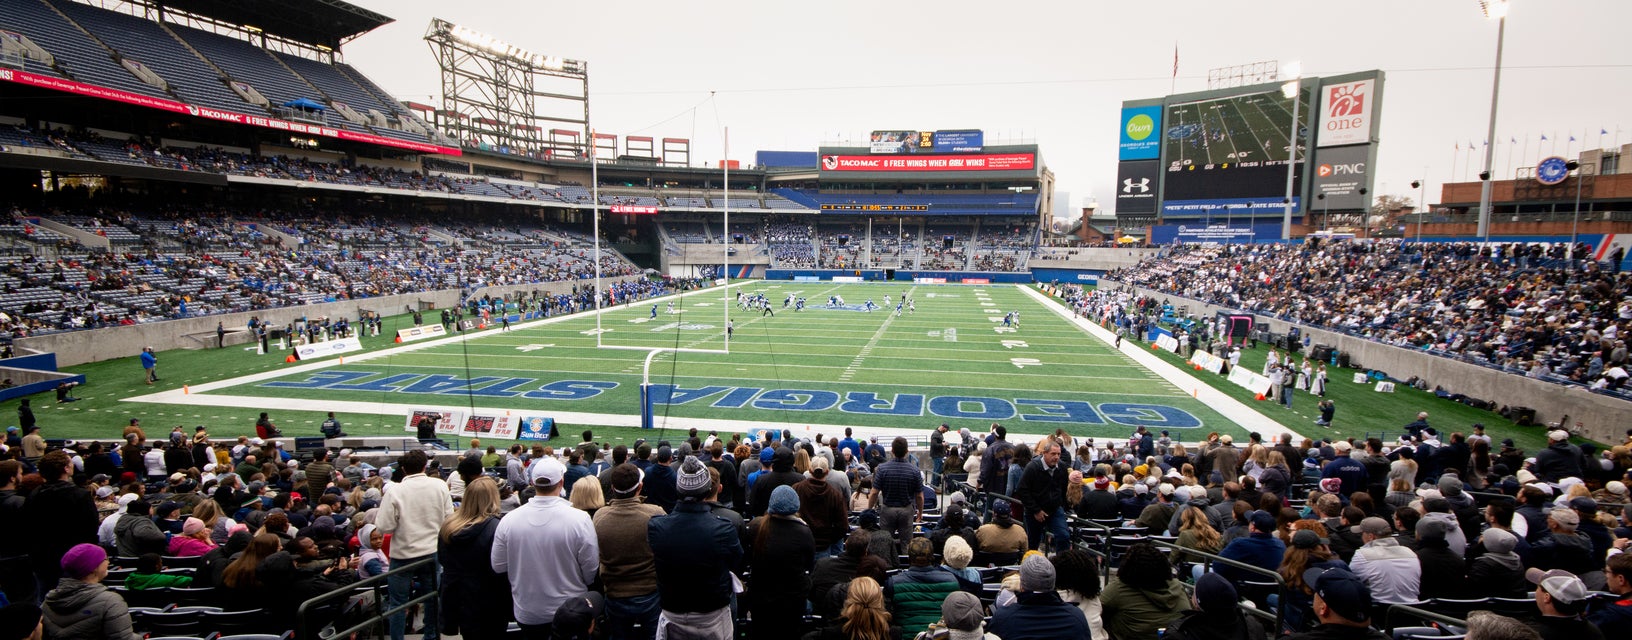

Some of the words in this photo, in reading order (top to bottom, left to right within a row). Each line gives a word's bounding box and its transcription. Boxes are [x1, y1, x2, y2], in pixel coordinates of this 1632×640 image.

[200, 108, 220, 118] TACO
[221, 112, 241, 122] MAC
[252, 118, 268, 126] FREE
[268, 120, 289, 129] WINGS
[290, 122, 307, 132] WHEN
[1128, 123, 1150, 132] Own
[1327, 118, 1362, 130] one
[1334, 163, 1365, 175] PNC
[255, 371, 620, 400] STATE
[652, 383, 1203, 429] GEORGIA
